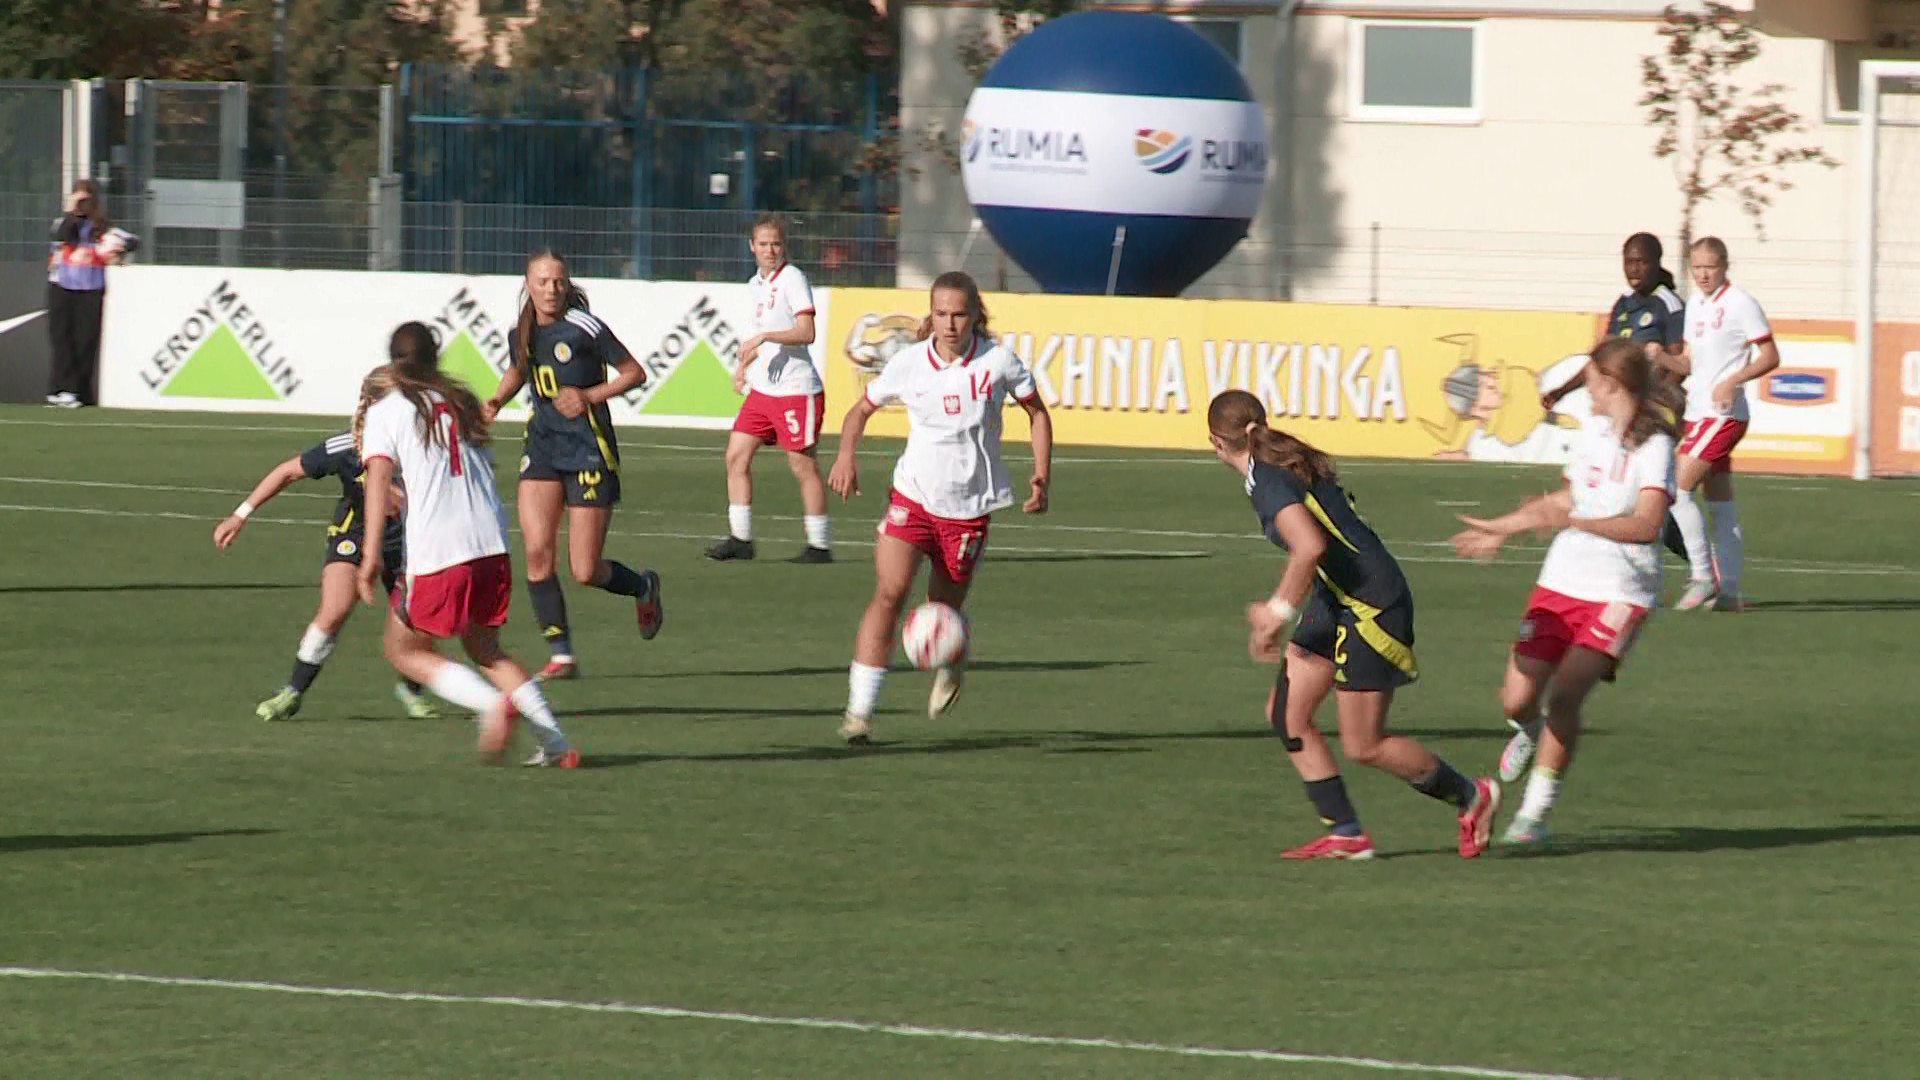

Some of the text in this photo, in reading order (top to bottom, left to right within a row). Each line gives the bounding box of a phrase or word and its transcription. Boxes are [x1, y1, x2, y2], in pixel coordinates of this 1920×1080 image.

[988, 127, 1088, 162] RUMIA
[140, 279, 303, 397] LEROY MERLIN
[691, 294, 742, 362] MER
[532, 365, 559, 400] 10
[969, 369, 993, 402] 14
[1202, 339, 1406, 421] VIKINGA
[783, 408, 800, 435] 5
[1335, 624, 1348, 664] 2
